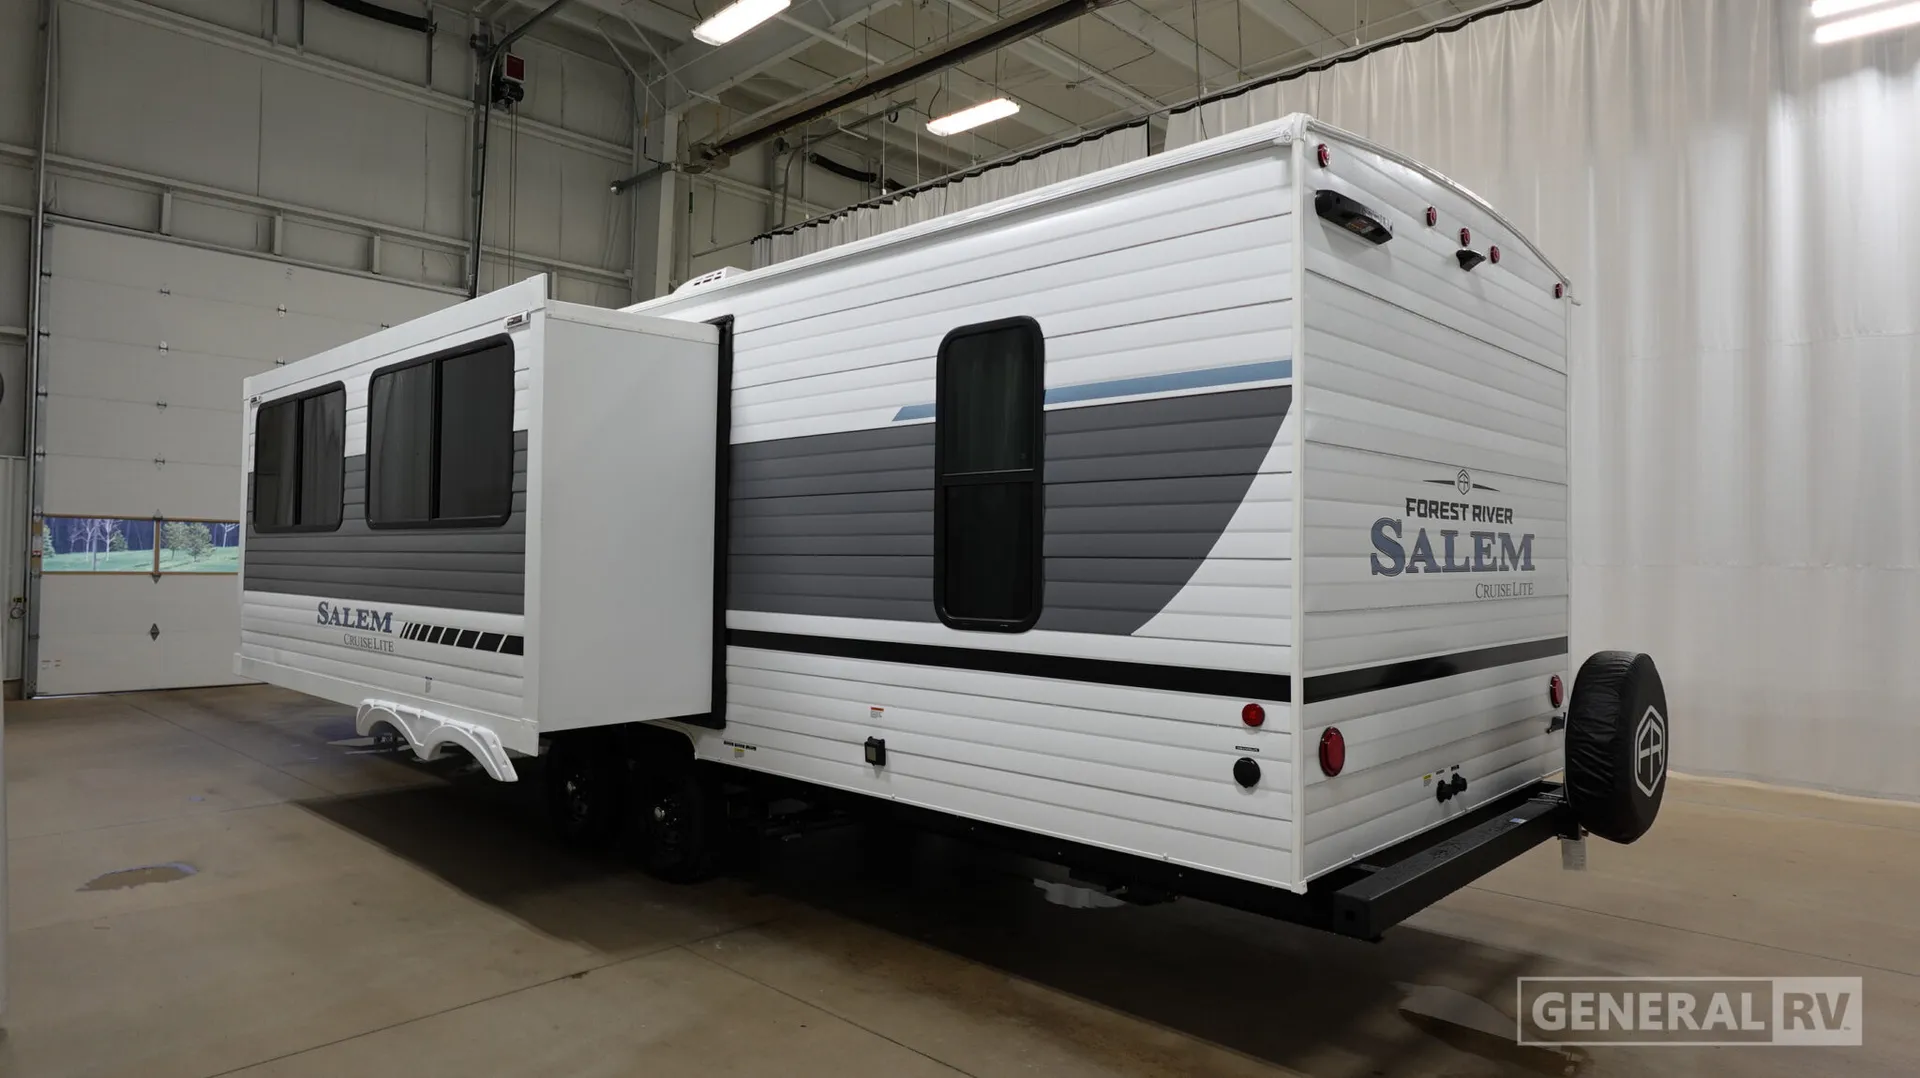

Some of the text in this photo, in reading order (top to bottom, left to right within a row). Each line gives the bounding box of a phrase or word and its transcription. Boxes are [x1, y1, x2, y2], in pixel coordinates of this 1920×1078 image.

[1405, 497, 1513, 525] FOREST RIVER
[1370, 517, 1536, 577] SALEM
[317, 601, 393, 634] SALEM
